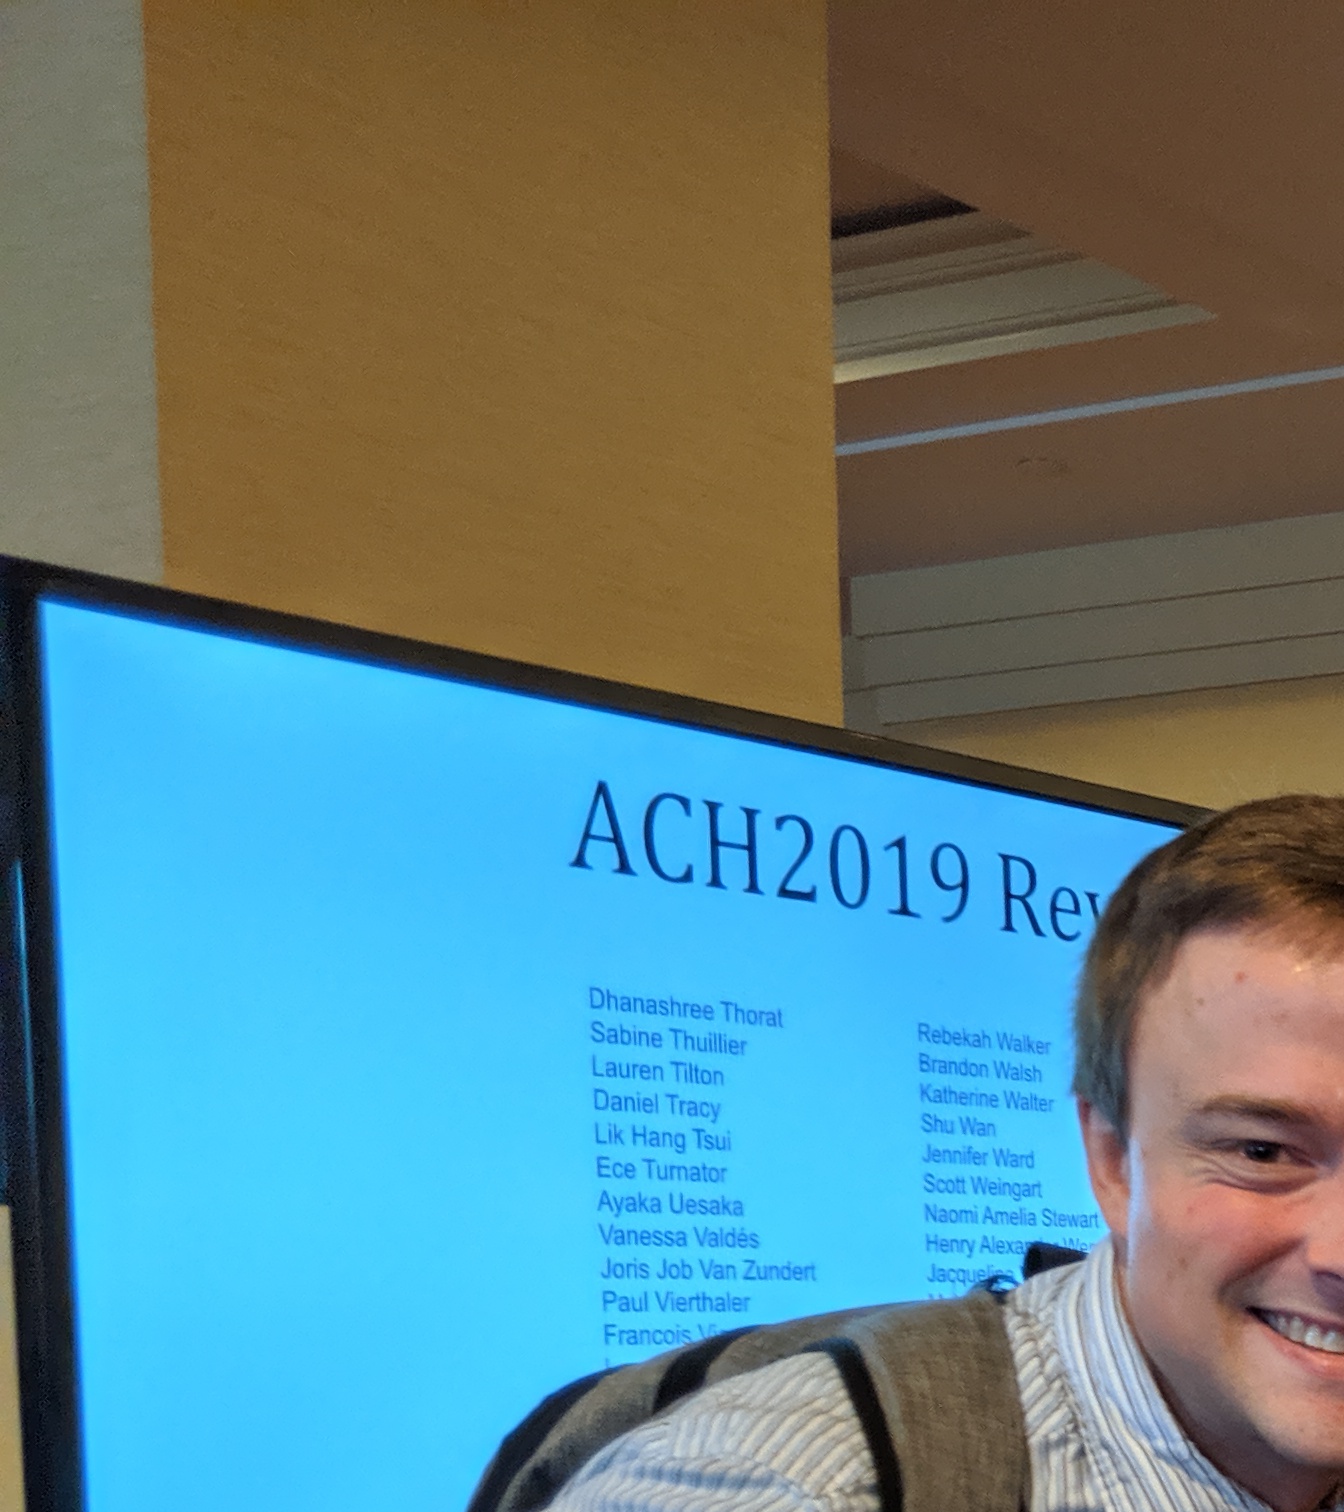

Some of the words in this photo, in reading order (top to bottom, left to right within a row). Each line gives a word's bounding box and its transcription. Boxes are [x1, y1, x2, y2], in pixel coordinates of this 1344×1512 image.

[568, 779, 971, 922] ACH2019
[589, 987, 715, 1021] Dhanashree
[720, 1001, 784, 1028] Thorat
[590, 1021, 663, 1048] Sabine
[669, 1028, 747, 1056] Thuillier
[918, 1022, 991, 1048] Rebekah
[996, 1032, 1052, 1055] Walker
[592, 1055, 664, 1082] Lauren
[670, 1061, 724, 1086] Tilton
[918, 1053, 989, 1078] Brandon
[993, 1060, 1042, 1082] Walsh
[594, 1088, 659, 1114] Daniel
[665, 1094, 721, 1124] Tracy
[920, 1083, 999, 1108] Katherine
[1003, 1090, 1054, 1112] Walter
[595, 1122, 624, 1146] Lik
[632, 1125, 686, 1154] Hang
[692, 1129, 731, 1151] Tsui
[921, 1112, 954, 1134] Shu
[959, 1116, 996, 1137] Wan
[596, 1156, 636, 1179] Ece
[922, 1144, 988, 1165] Jennifer
[992, 1148, 1034, 1168] Ward
[923, 1173, 966, 1194] Scott
[970, 1176, 1042, 1201] Weingart
[597, 1190, 662, 1218] Ayaka
[669, 1192, 744, 1216] Uesaka
[924, 1203, 978, 1224] Naomi
[982, 1205, 1037, 1226] Amelia
[1041, 1208, 1100, 1228] Stewart
[598, 1224, 688, 1247] Vanessa
[693, 1226, 760, 1249] Valdés
[925, 1234, 976, 1258] Henry
[600, 1257, 650, 1280] Joris
[657, 1258, 693, 1280] Job
[699, 1259, 737, 1280] Van
[742, 1260, 816, 1282] Zundert
[602, 1290, 648, 1312] Paul
[655, 1290, 750, 1312] Vierthaler
